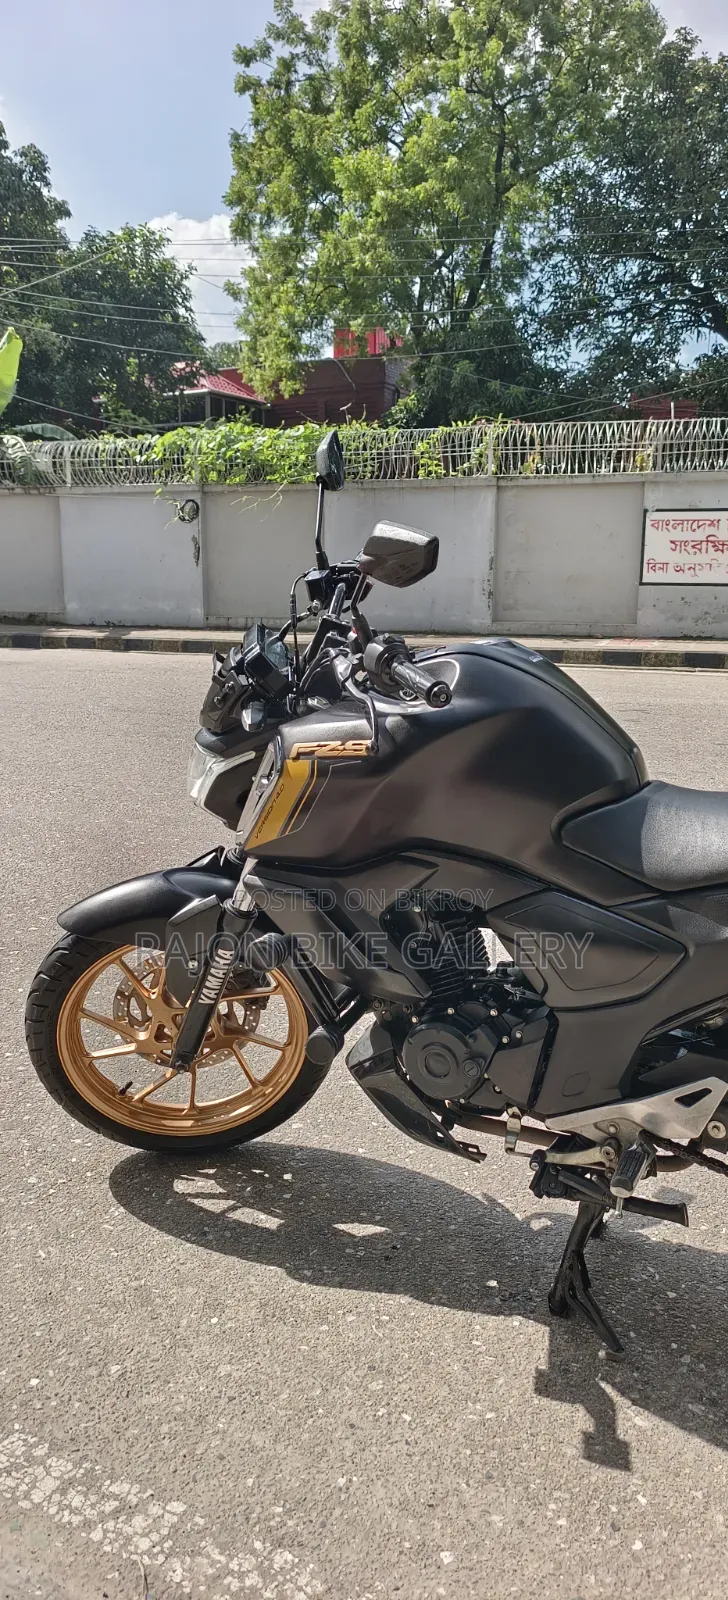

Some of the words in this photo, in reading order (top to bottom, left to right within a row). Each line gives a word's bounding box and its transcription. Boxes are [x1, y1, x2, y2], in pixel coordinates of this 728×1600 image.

[650, 519, 721, 532] বাংলাদেশ
[646, 558, 669, 574] বিনা
[198, 948, 234, 1004] YAMAHA
